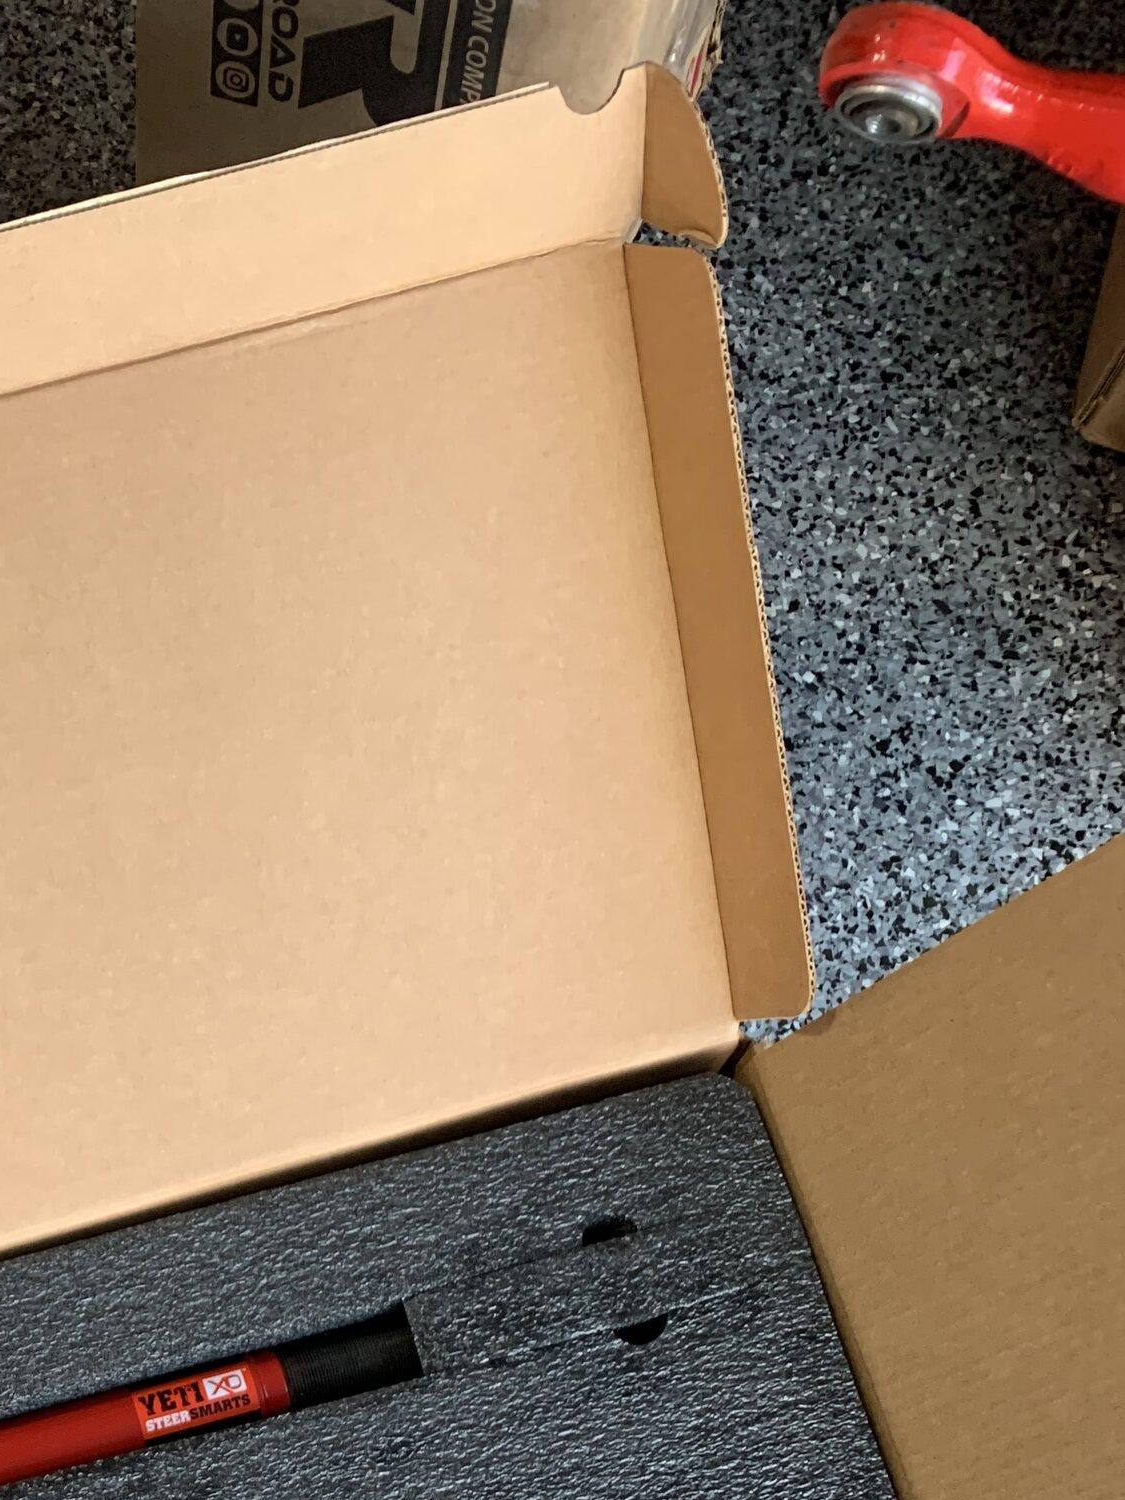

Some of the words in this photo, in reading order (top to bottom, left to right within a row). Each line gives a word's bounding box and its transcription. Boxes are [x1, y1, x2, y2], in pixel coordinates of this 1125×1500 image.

[268, 0, 299, 102] OAD
[138, 1381, 203, 1416] YETI
[145, 1394, 251, 1432] STEERSMARTS
